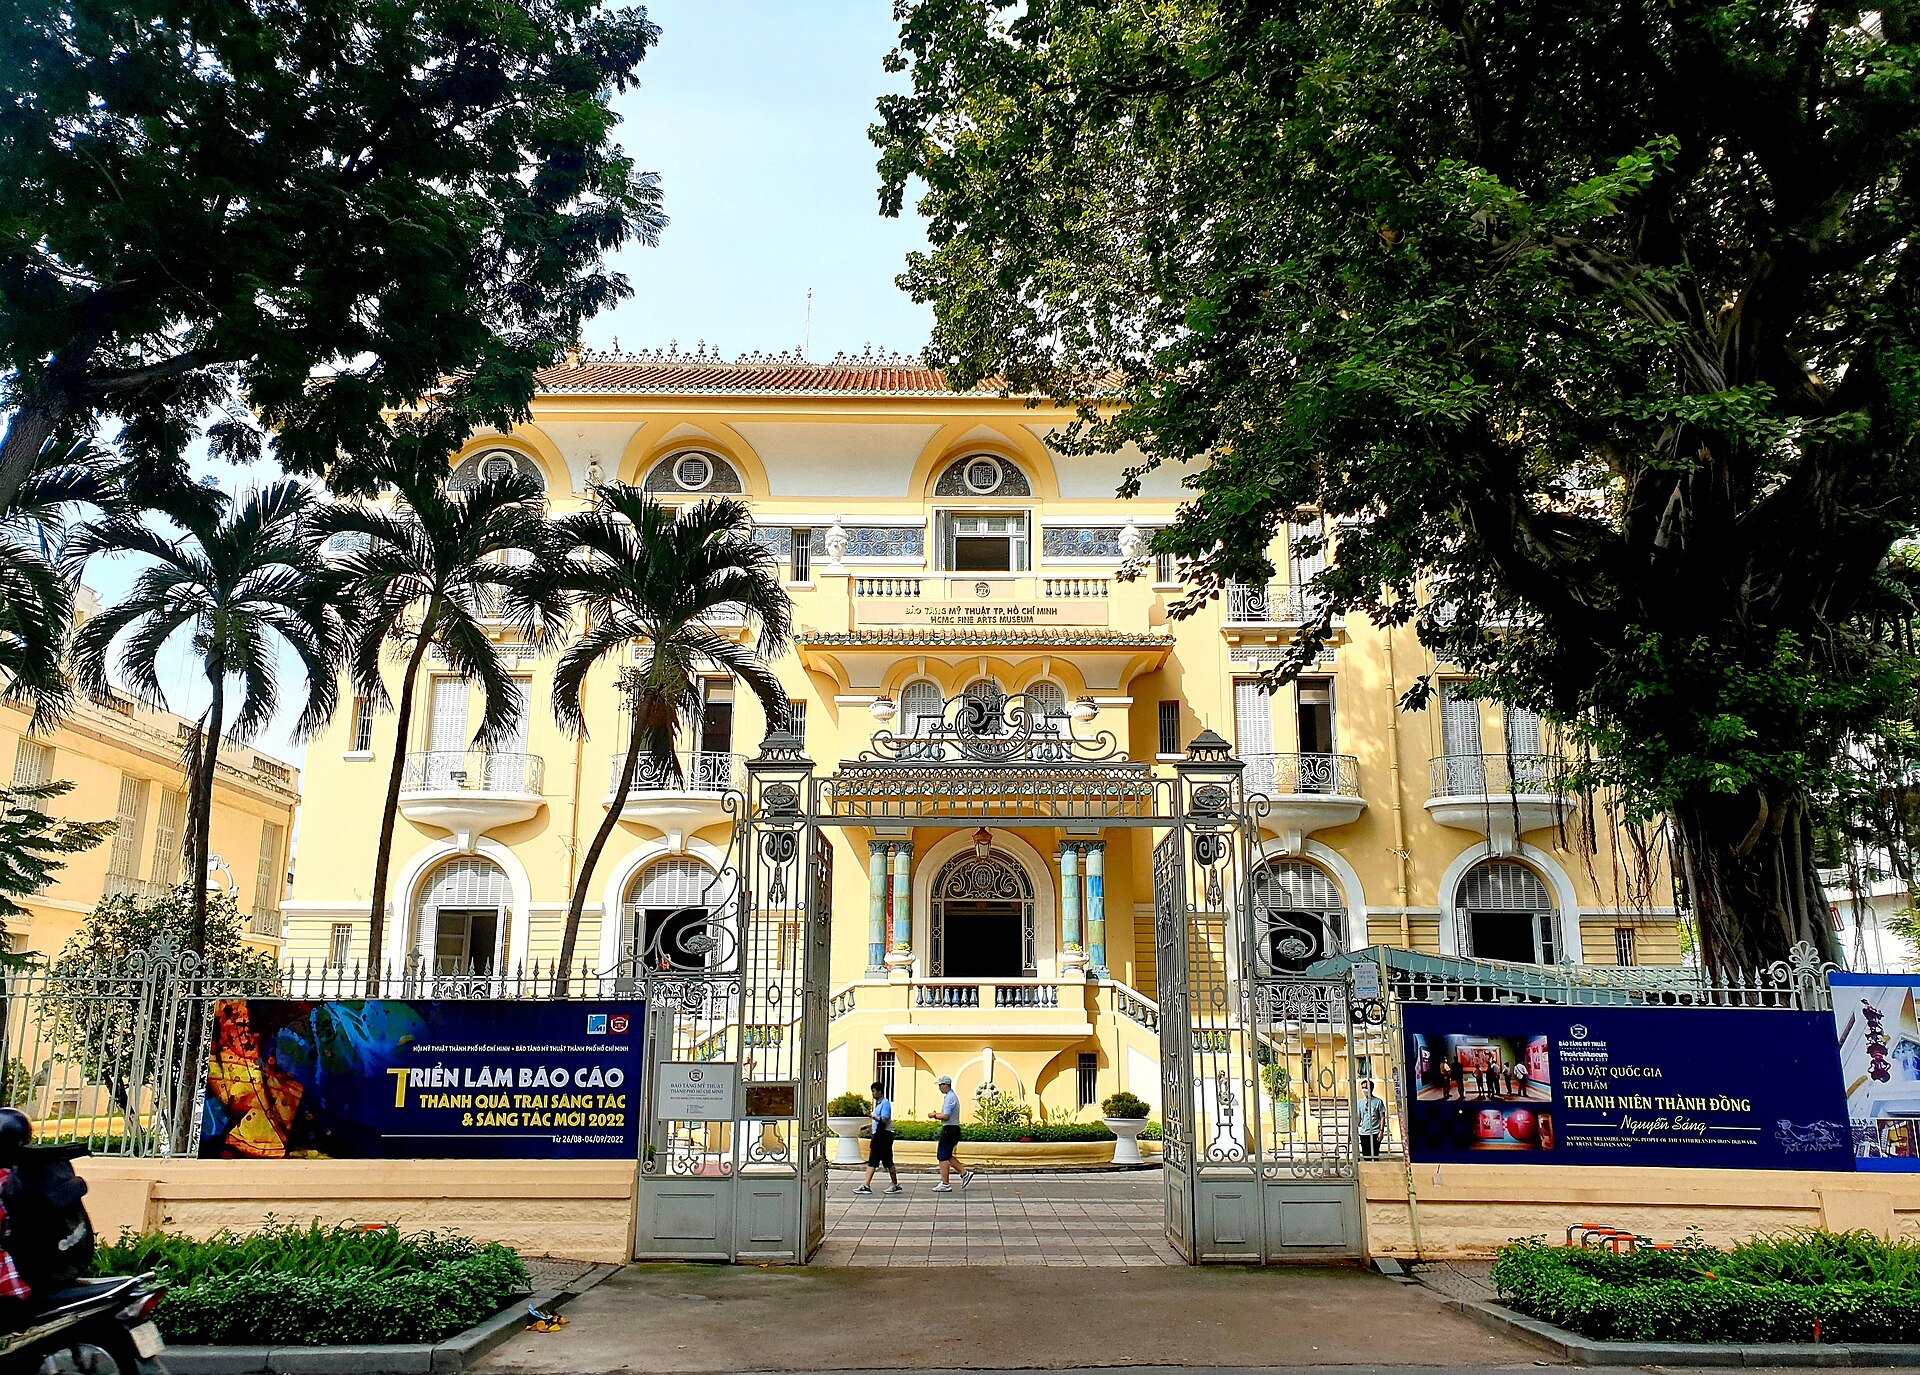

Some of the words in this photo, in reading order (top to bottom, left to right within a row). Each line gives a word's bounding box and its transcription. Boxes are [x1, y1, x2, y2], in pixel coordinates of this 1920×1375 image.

[964, 606, 991, 616] THUẬT
[993, 607, 1006, 615] TP.
[1021, 605, 1036, 615] CHÍ
[1037, 607, 1058, 615] MINH
[1562, 1064, 1585, 1077] BẢO
[1587, 1064, 1608, 1079] VẬT
[1610, 1065, 1641, 1079] QUỐC
[1643, 1067, 1663, 1078] GIA
[386, 1062, 460, 1108] TRIỂN
[464, 1065, 514, 1088] LÃM
[518, 1065, 570, 1088] BÁO
[574, 1065, 625, 1088] CÁO
[1562, 1080, 1579, 1090] TÁC
[419, 1092, 473, 1109] THÀNH
[513, 1094, 548, 1111] TRẠI
[551, 1092, 594, 1109] SÁNG
[596, 1092, 626, 1109] TÁC
[1564, 1095, 1615, 1109] THANH
[1618, 1093, 1652, 1110] NIÊN
[1654, 1094, 1707, 1111] THÀNH
[1709, 1094, 1751, 1112] ĐỒNG
[461, 1112, 474, 1127] &
[476, 1110, 519, 1127] SÁNG
[522, 1110, 552, 1127] TÁC
[553, 1110, 586, 1127] MỚI
[588, 1113, 625, 1127] 2022
[1620, 1114, 1670, 1134] Nguyễn
[1672, 1115, 1707, 1136] Sáng
[552, 1135, 562, 1144] Từ
